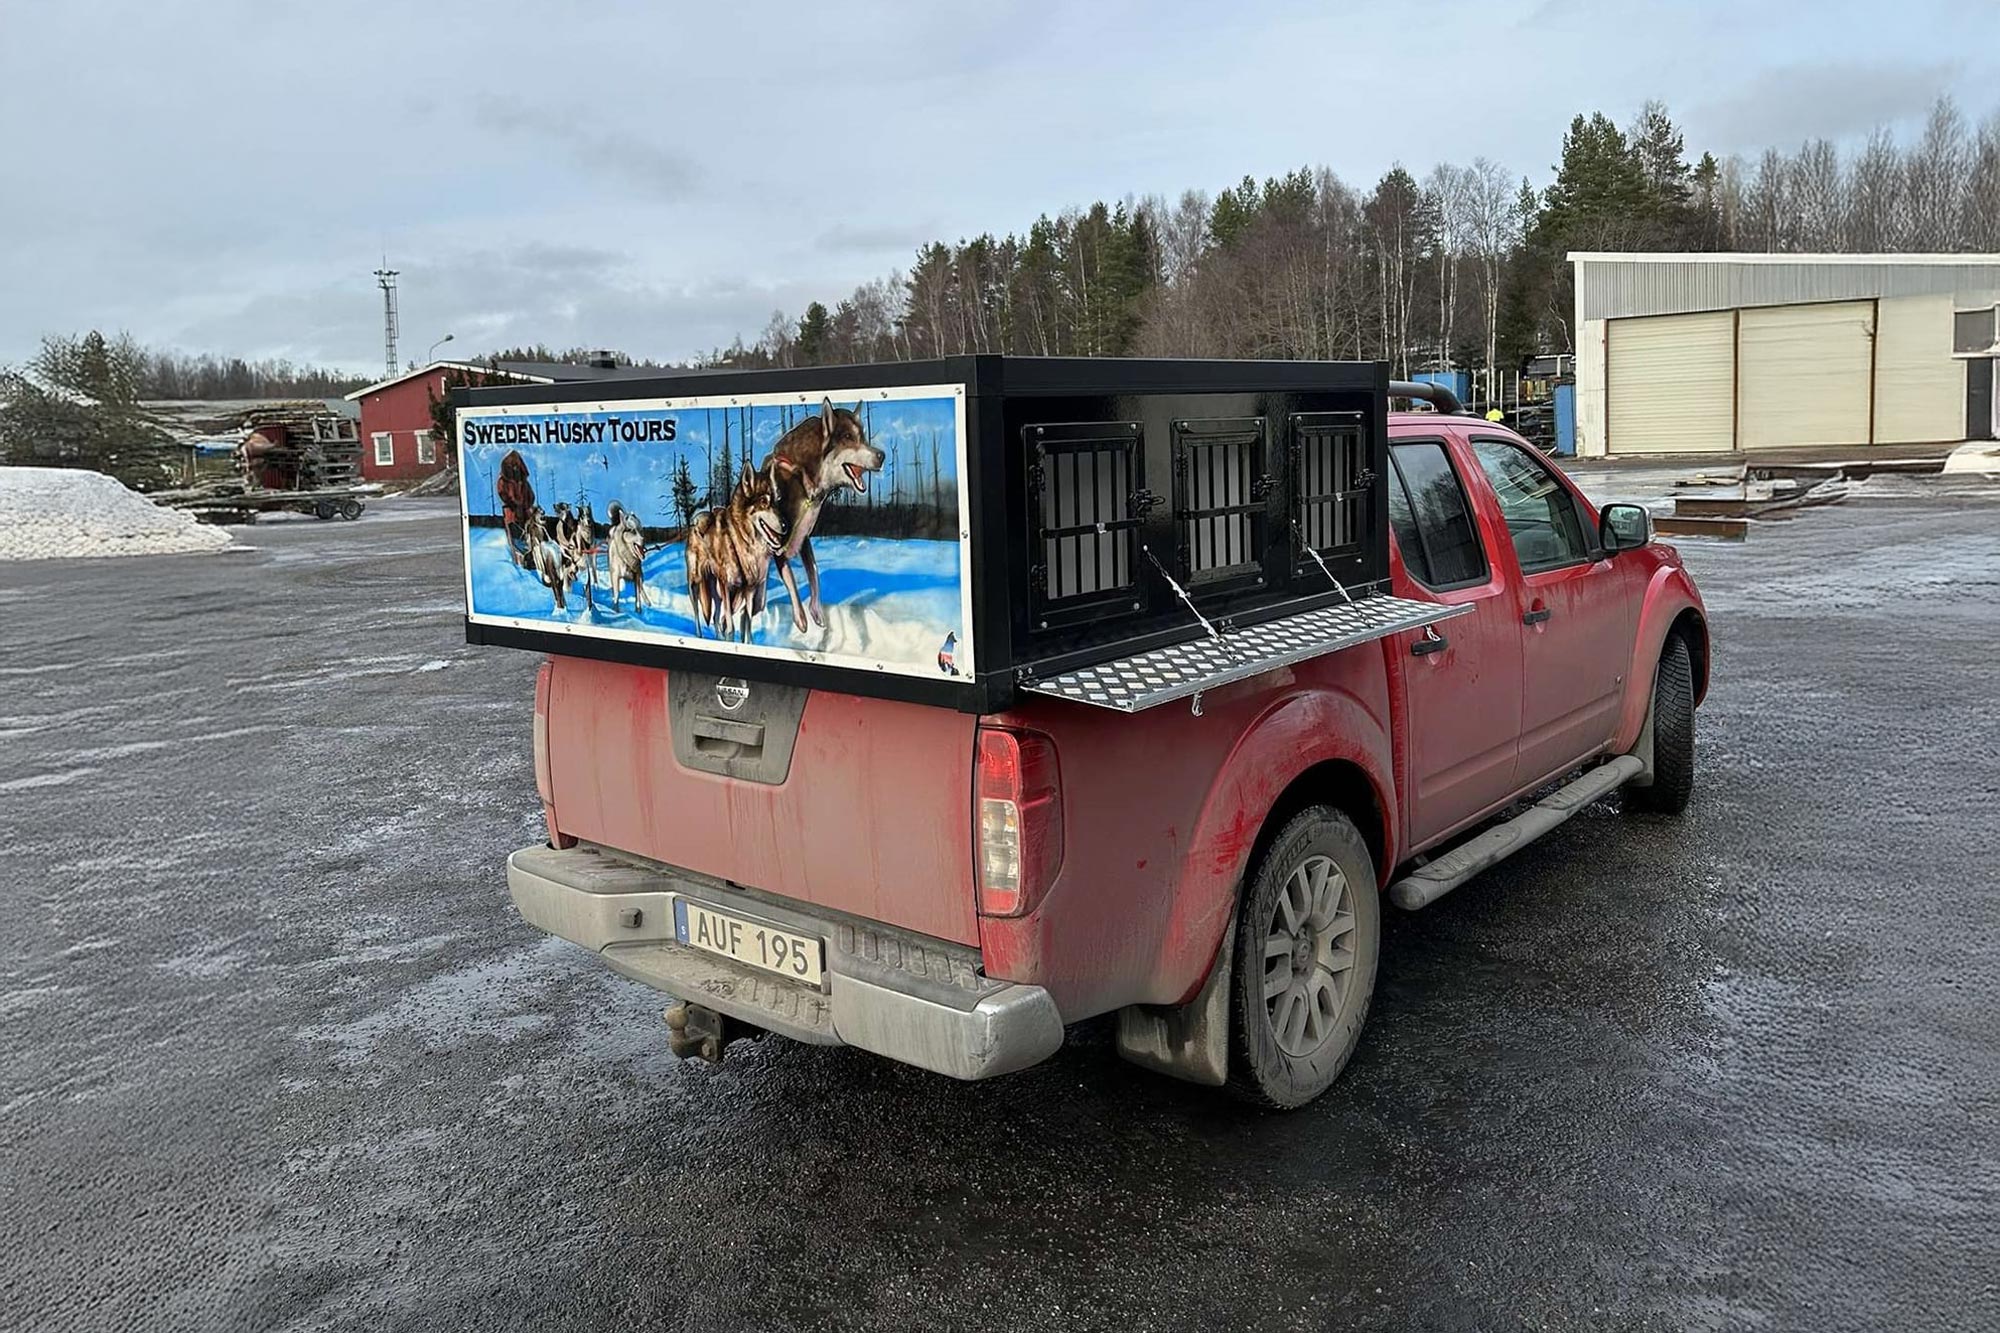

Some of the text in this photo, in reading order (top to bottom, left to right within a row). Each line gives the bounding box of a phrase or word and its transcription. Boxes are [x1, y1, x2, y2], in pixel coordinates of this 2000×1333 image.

[464, 418, 676, 445] SWEDEN HUSKY TOURS
[681, 925, 686, 935] S
[698, 912, 808, 975] AUF 195
